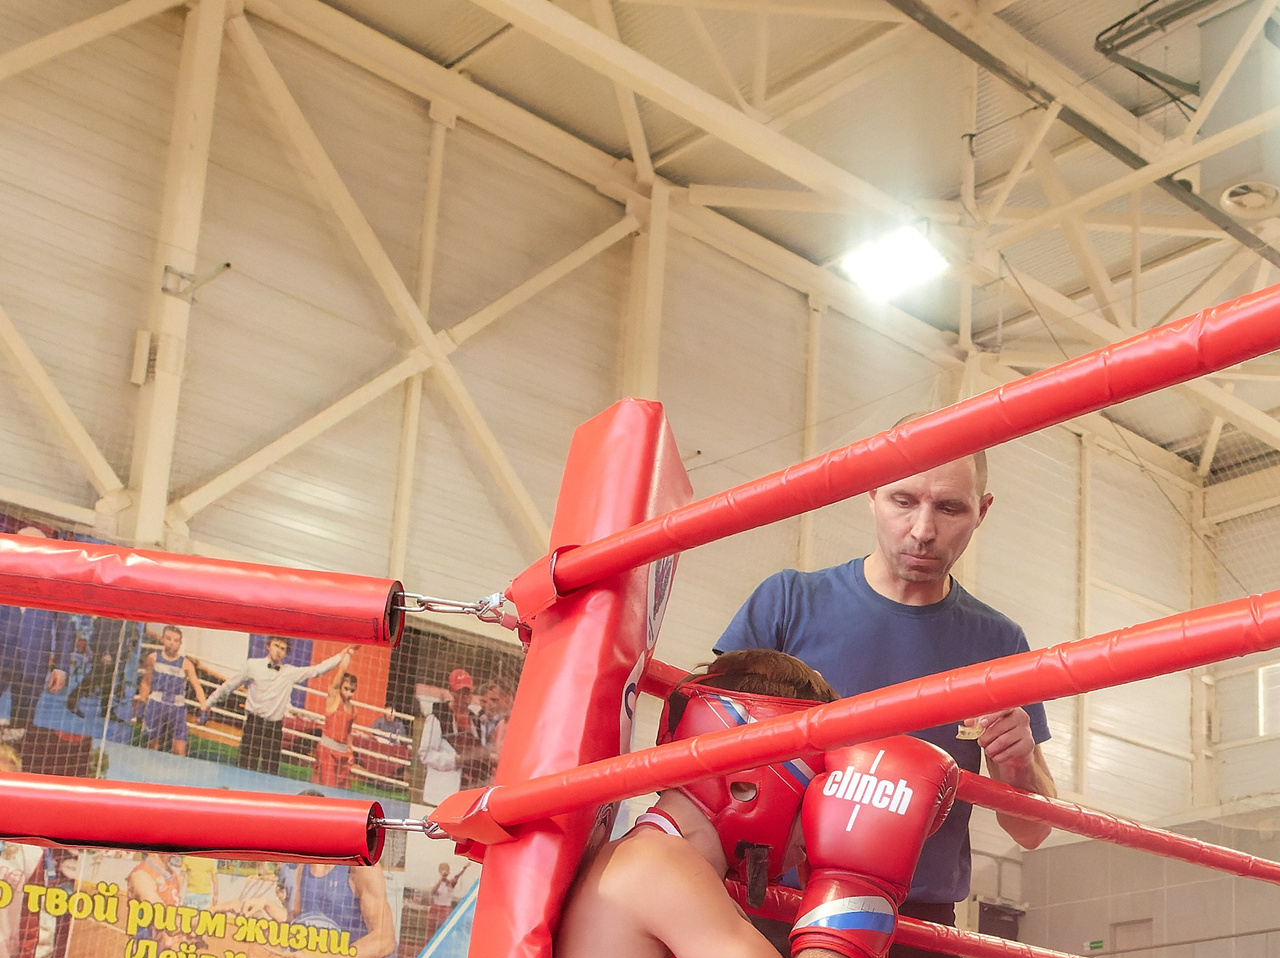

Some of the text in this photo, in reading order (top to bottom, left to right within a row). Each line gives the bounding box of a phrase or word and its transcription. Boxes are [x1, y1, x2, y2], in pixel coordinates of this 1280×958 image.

[823, 766, 914, 816] clinch
[23, 881, 119, 924] твой
[126, 899, 227, 938] ритм
[232, 915, 358, 957] жизни.
